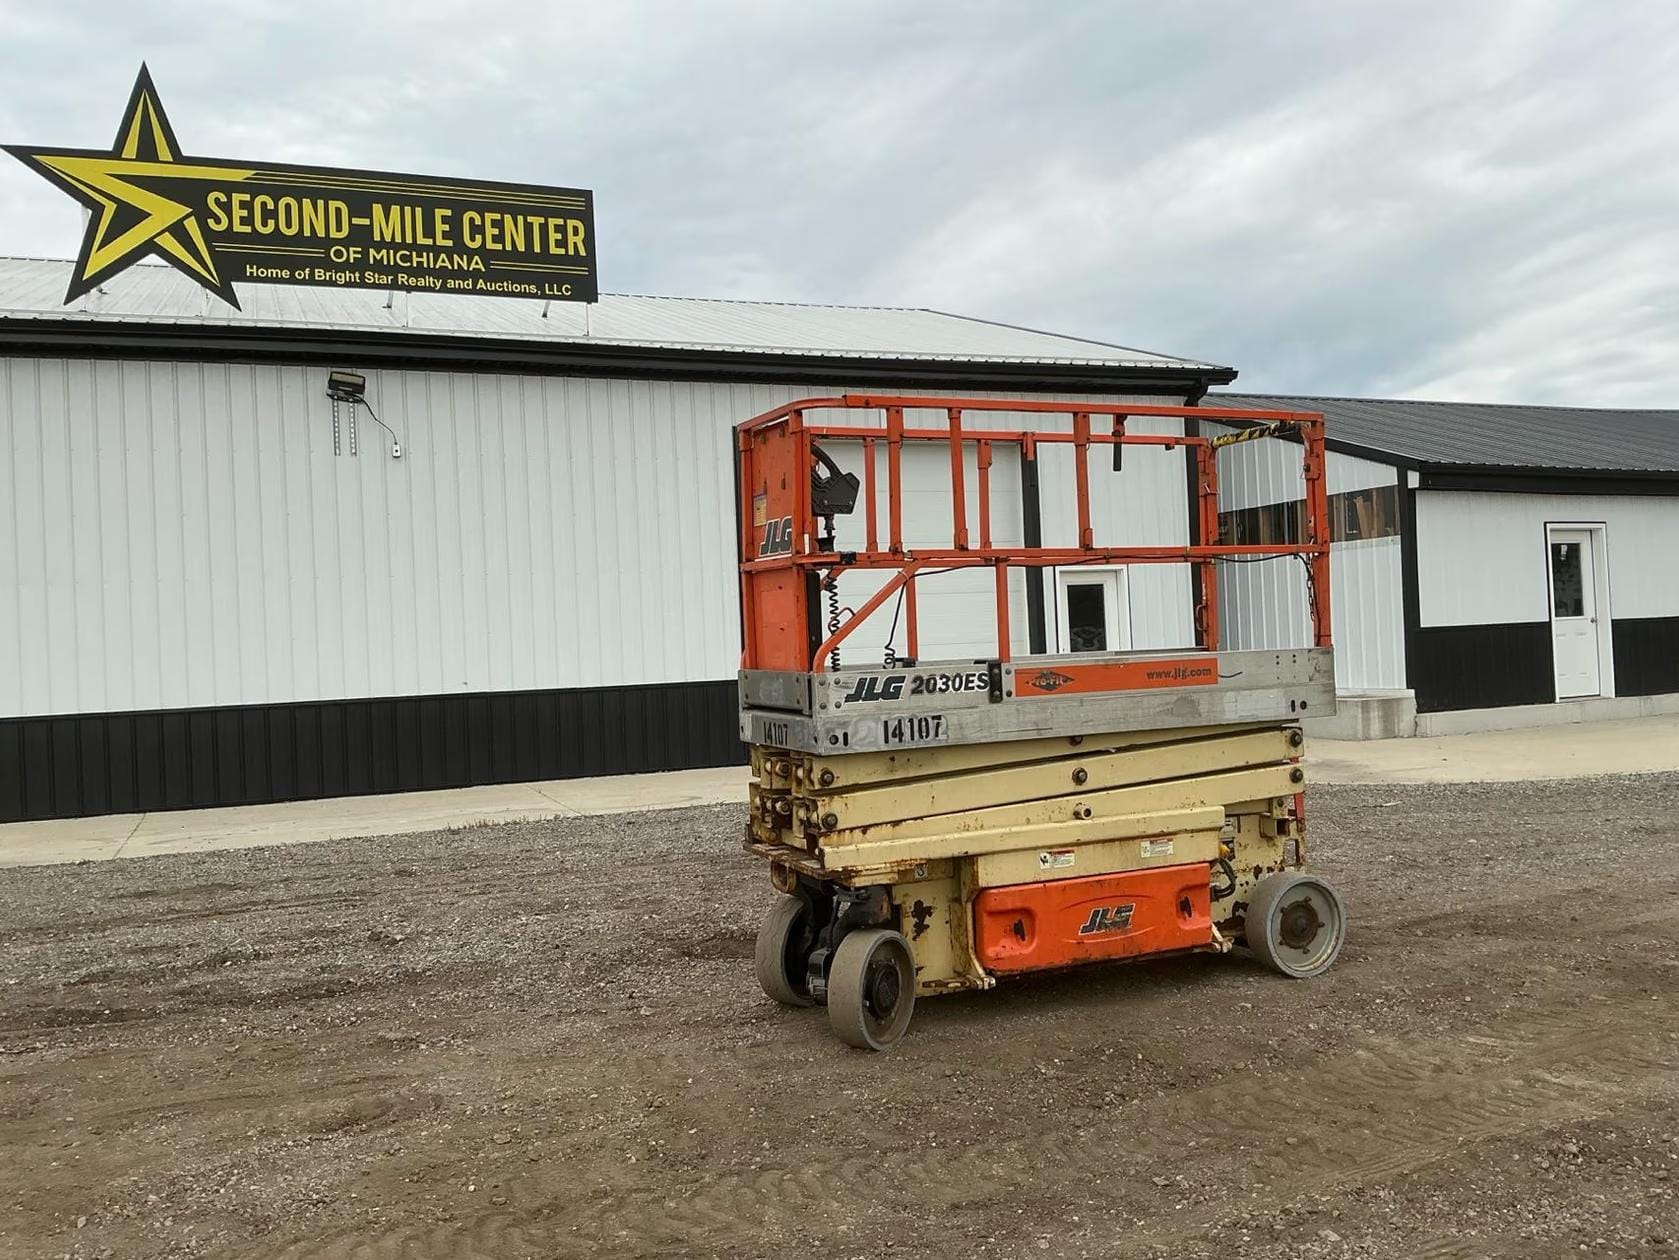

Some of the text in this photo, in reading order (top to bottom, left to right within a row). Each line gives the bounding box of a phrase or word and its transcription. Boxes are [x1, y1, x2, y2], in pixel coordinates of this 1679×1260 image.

[206, 191, 587, 257] SECOND-MILE CENTER
[329, 245, 486, 273] OF MICHIANA
[246, 264, 572, 296] Home of Bright Star Realty and Auctions, LLC
[759, 515, 792, 557] JLG
[844, 671, 990, 704] JLG 2030ES
[1146, 666, 1212, 681] www.jlg.com
[763, 720, 788, 746] 14107
[883, 714, 943, 745] 14107
[1078, 902, 1136, 936] JLG
